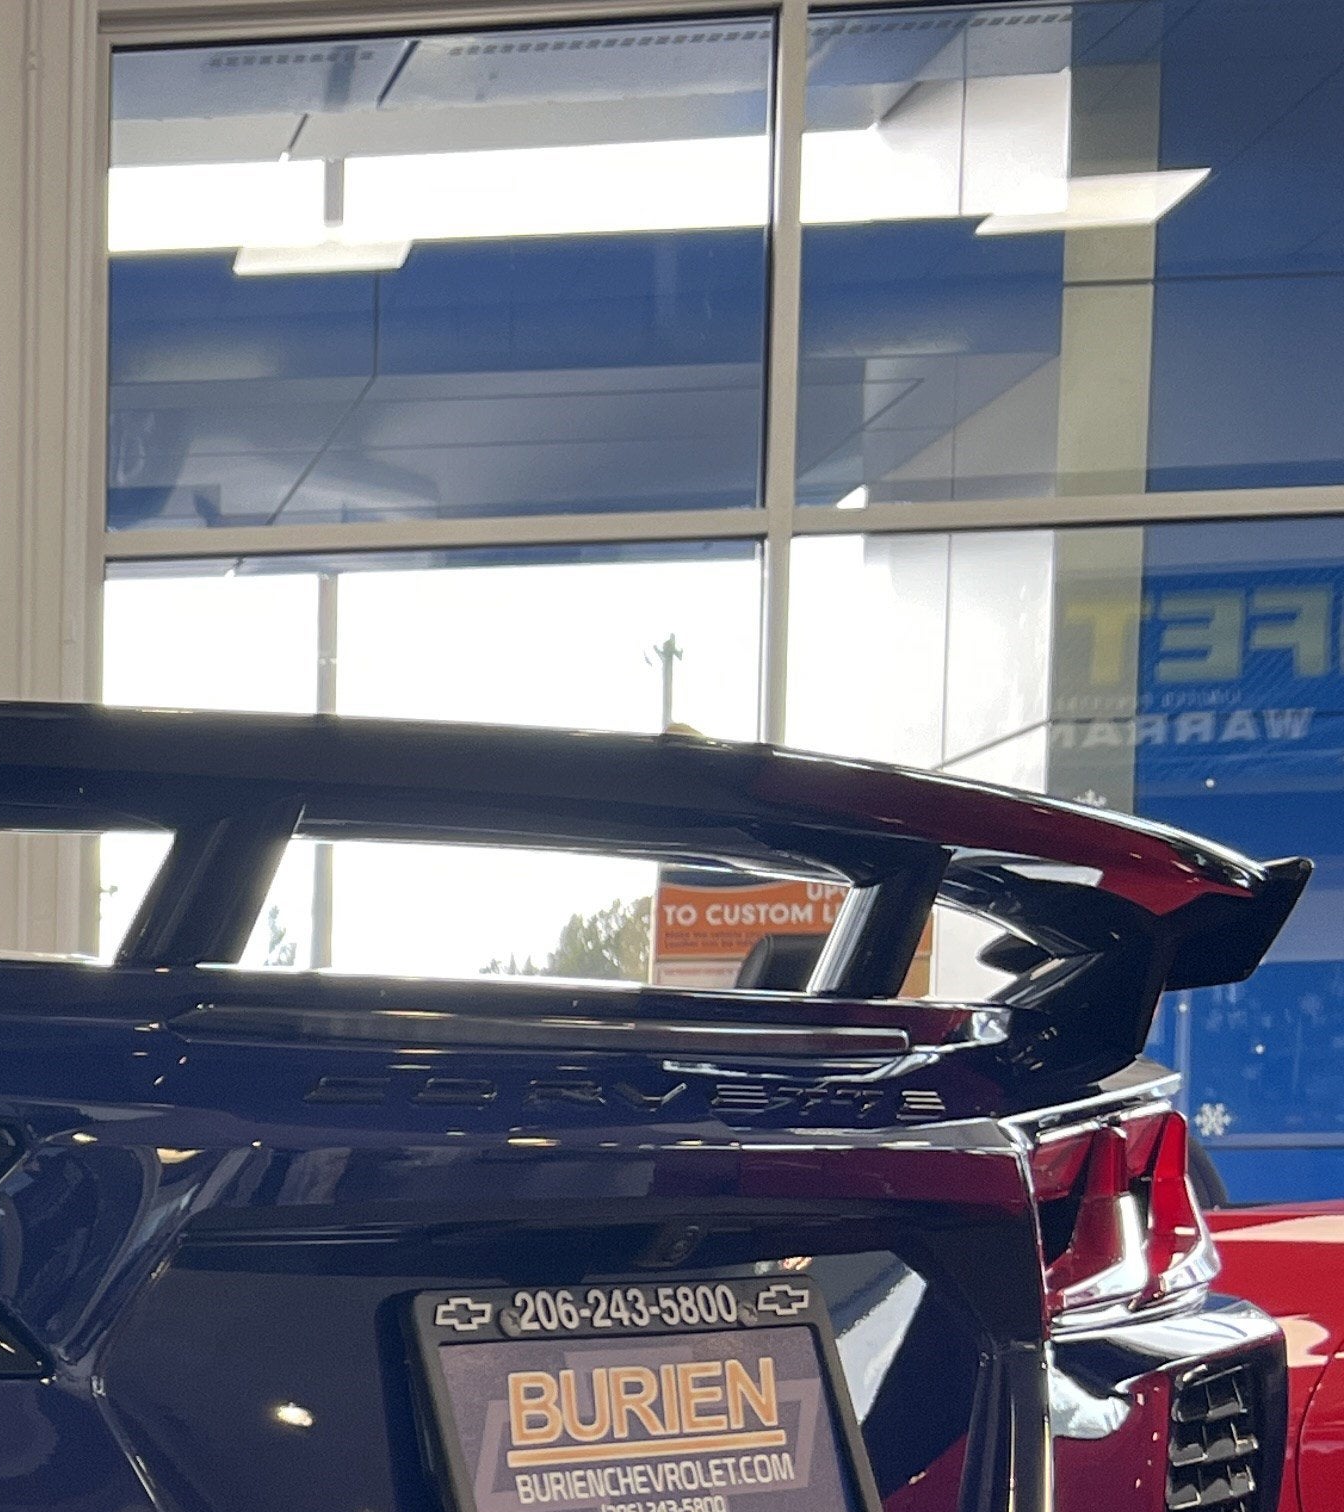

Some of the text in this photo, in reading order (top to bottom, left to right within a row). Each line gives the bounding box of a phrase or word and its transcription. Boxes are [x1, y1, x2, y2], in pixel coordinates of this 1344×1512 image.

[663, 904, 697, 927] TO
[705, 903, 814, 926] CUSTOM
[513, 1284, 738, 1331] 206-243-5800
[507, 1356, 779, 1446] BURIEN
[515, 1452, 795, 1504] BURIENCHEVROLET.COM
